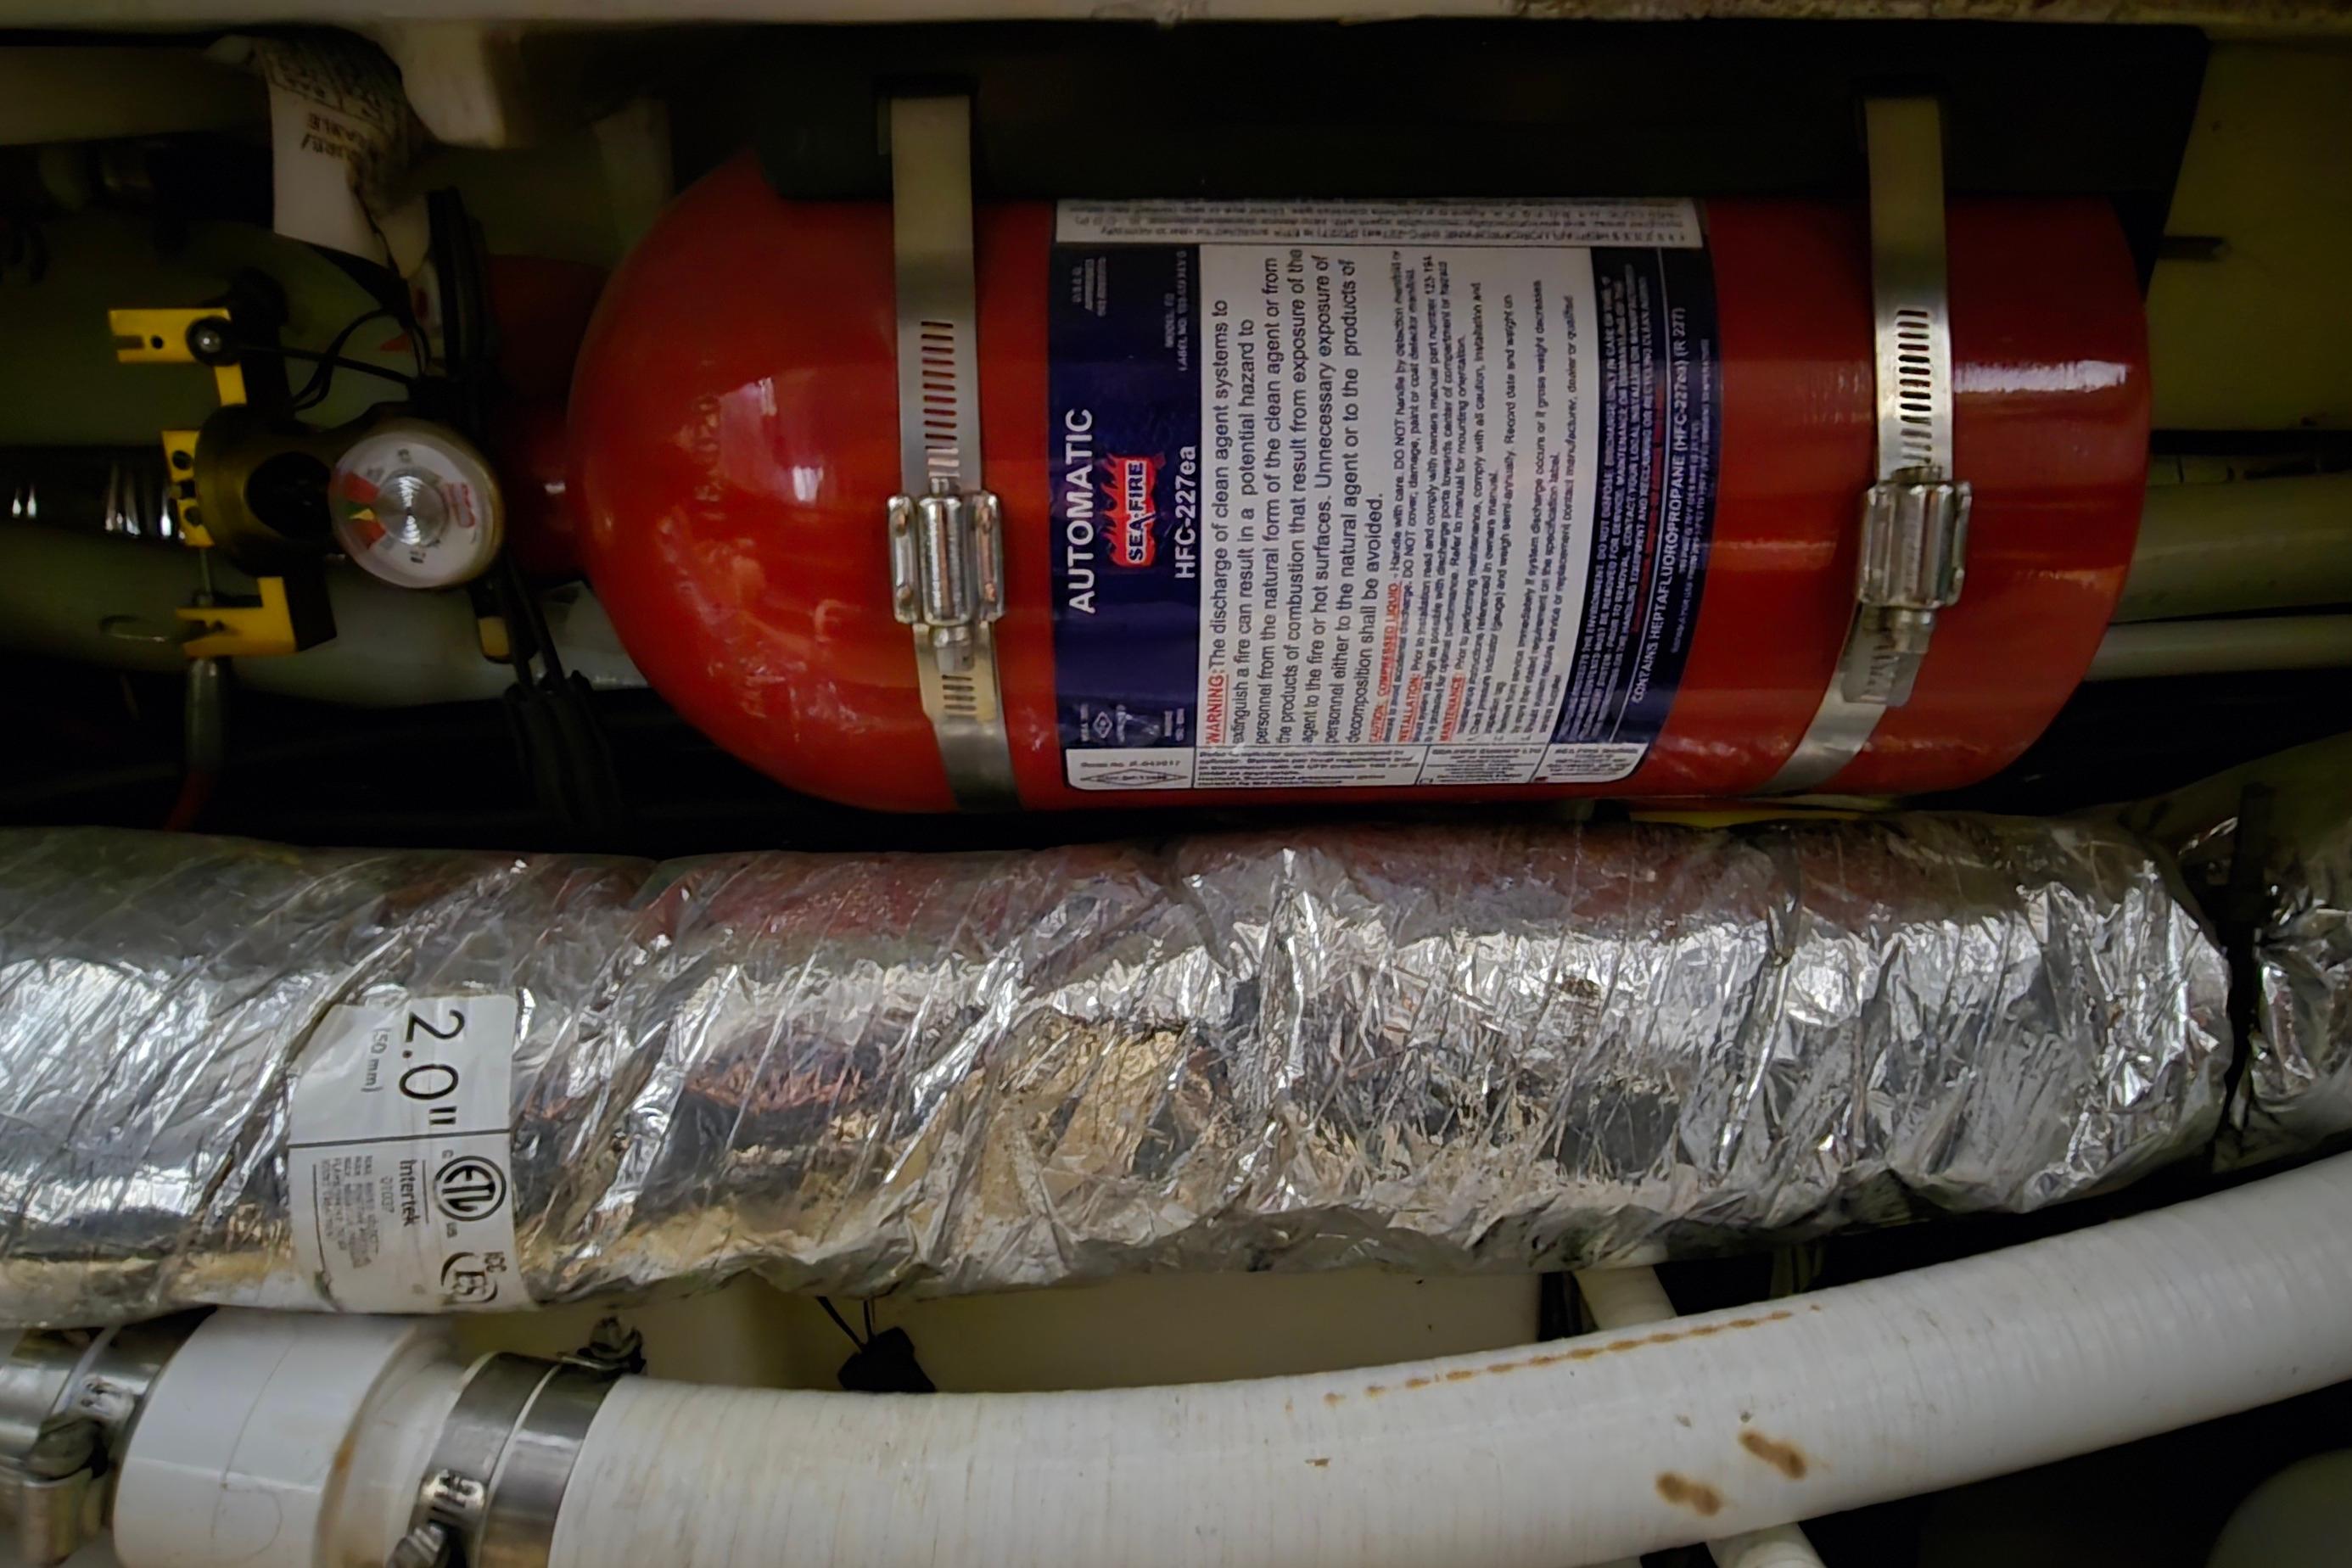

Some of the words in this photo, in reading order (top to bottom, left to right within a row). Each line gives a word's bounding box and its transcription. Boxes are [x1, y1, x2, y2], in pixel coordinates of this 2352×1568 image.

[1263, 258, 1278, 294] from
[1287, 249, 1303, 273] the
[1312, 255, 1328, 271] of
[1338, 260, 1354, 276] of
[1288, 278, 1304, 294] of
[1212, 300, 1228, 316] to
[1266, 300, 1279, 317] or
[1315, 277, 1335, 356] exposure
[1341, 281, 1361, 356] products
[1238, 319, 1253, 336] to
[1290, 300, 1308, 383] exposure
[1212, 322, 1232, 399] systems
[1264, 323, 1284, 375] agent
[1238, 343, 1254, 406] hazard
[1395, 360, 1406, 372] by
[1342, 369, 1358, 397] the
[1395, 377, 1405, 415] handle
[1442, 387, 1452, 397] of
[1264, 382, 1280, 432] clean
[1290, 389, 1306, 432] from
[1342, 404, 1358, 422] to
[1409, 406, 1420, 434] paint
[1212, 406, 1233, 460] agent
[1314, 363, 1336, 488] Unnecessary
[1344, 428, 1358, 447] or
[1395, 419, 1405, 445] NOT
[1474, 430, 1483, 452] with
[1239, 413, 1257, 495] potential
[1265, 439, 1280, 468] the
[1289, 438, 1306, 491] result
[1394, 450, 1404, 469] DO
[1427, 458, 1436, 481] with
[1212, 467, 1229, 518] clean
[1263, 473, 1280, 493] of
[1341, 453, 1361, 507] agent
[1473, 456, 1486, 497] comply
[1066, 409, 1096, 613] AUTOMATIC
[1173, 445, 1196, 579] HFC-227ea
[1240, 508, 1254, 519] a
[1263, 500, 1280, 540] form
[1289, 497, 1305, 533] that
[1393, 505, 1403, 527] with
[1426, 485, 1439, 525] comply
[1212, 523, 1229, 542] of
[1237, 526, 1254, 542] in
[1313, 496, 1331, 580] surfaces.
[1341, 514, 1357, 577] natural
[1364, 493, 1383, 572] avoided.
[1404, 530, 1415, 556] NOT
[1425, 529, 1434, 549] and
[1389, 531, 1402, 571] Handle
[1423, 553, 1432, 577] read
[1235, 548, 1253, 597] result
[1263, 548, 1279, 609] natural
[1403, 559, 1414, 578] DO
[1631, 642, 1659, 703] CONTAINS
[1649, 455, 1685, 639] HEPTAFLUOROPROPANE
[1210, 548, 1231, 634] discharge
[1287, 540, 1305, 640] combustion
[1310, 585, 1328, 613] hot
[1336, 584, 1353, 610] the
[1362, 579, 1379, 600] be
[1237, 603, 1252, 634] can
[1260, 614, 1276, 640] the
[1310, 618, 1325, 635] or
[1336, 616, 1351, 630] to
[1358, 607, 1377, 643] shall
[1234, 639, 1250, 664] fire
[1258, 647, 1274, 679] from
[1284, 645, 1299, 659] of
[1307, 641, 1324, 664] fire
[1331, 636, 1348, 679] either
[1235, 668, 1248, 677] a
[1305, 669, 1322, 691] the
[1280, 664, 1298, 722] products
[1304, 696, 1319, 708] to
[1346, 649, 1372, 742] decomposition
[1230, 681, 1250, 744] extinguish
[1255, 684, 1273, 744] personnel
[1300, 710, 1319, 743] agent
[1324, 683, 1344, 743] personnel
[1276, 727, 1292, 743] the
[361, 1059, 383, 1093] mm)
[400, 1160, 419, 1226] Intertek
